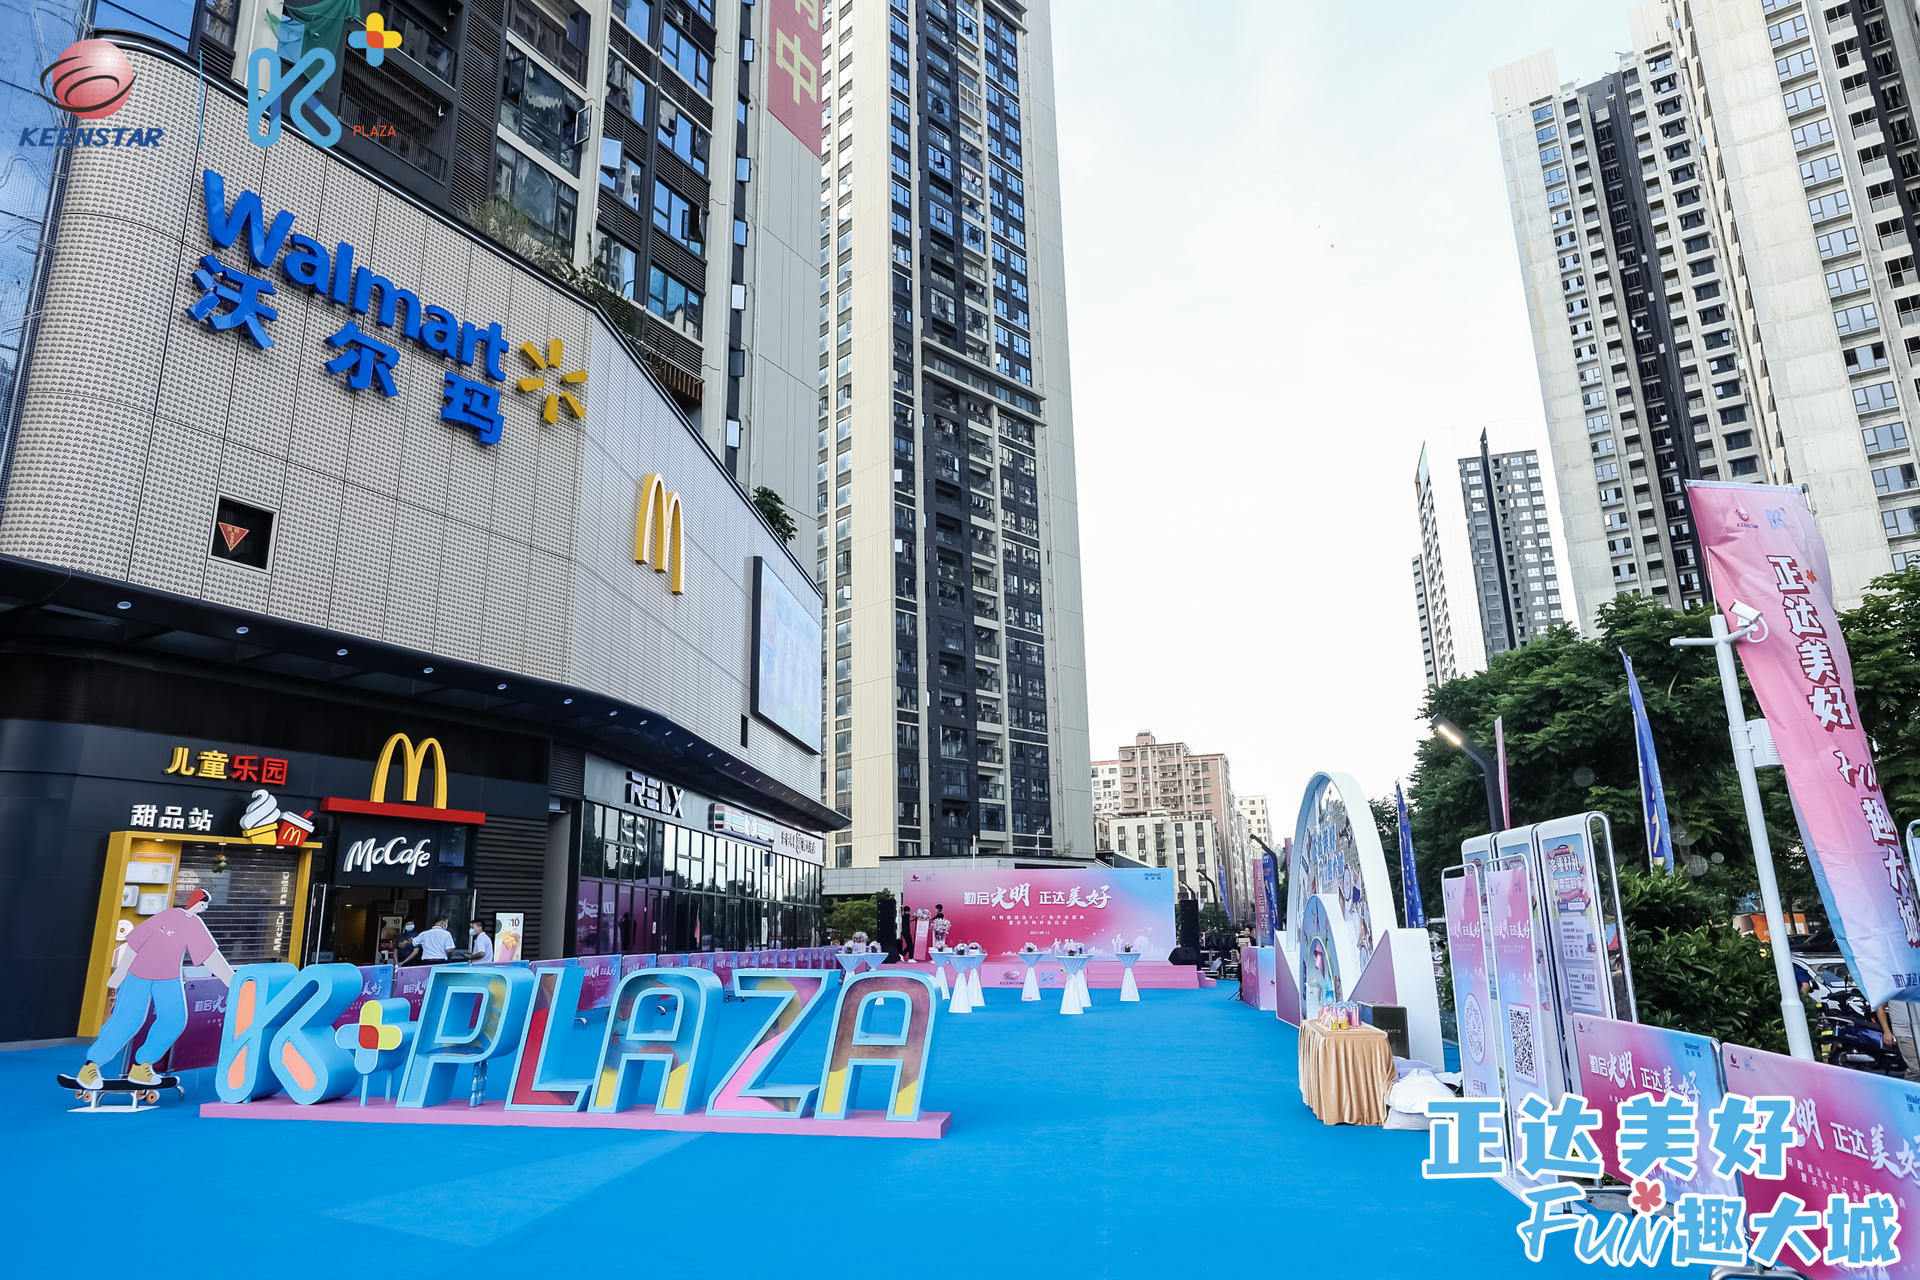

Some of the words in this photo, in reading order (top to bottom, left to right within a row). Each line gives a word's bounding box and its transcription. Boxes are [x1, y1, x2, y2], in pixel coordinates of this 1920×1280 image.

[775, 0, 819, 105] 中
[204, 168, 509, 381] Walmart
[185, 254, 505, 445] 沃尔玛
[1766, 555, 1856, 733] 正达美好
[164, 746, 289, 786] 儿童乐园
[625, 770, 685, 819] RELX
[130, 804, 214, 832] 甜品站
[1039, 884, 1112, 909] 正达美好
[400, 966, 944, 1122] PLAZA
[1639, 1064, 1702, 1106] 正达美好
[1829, 1121, 1920, 1188] 正达美好
